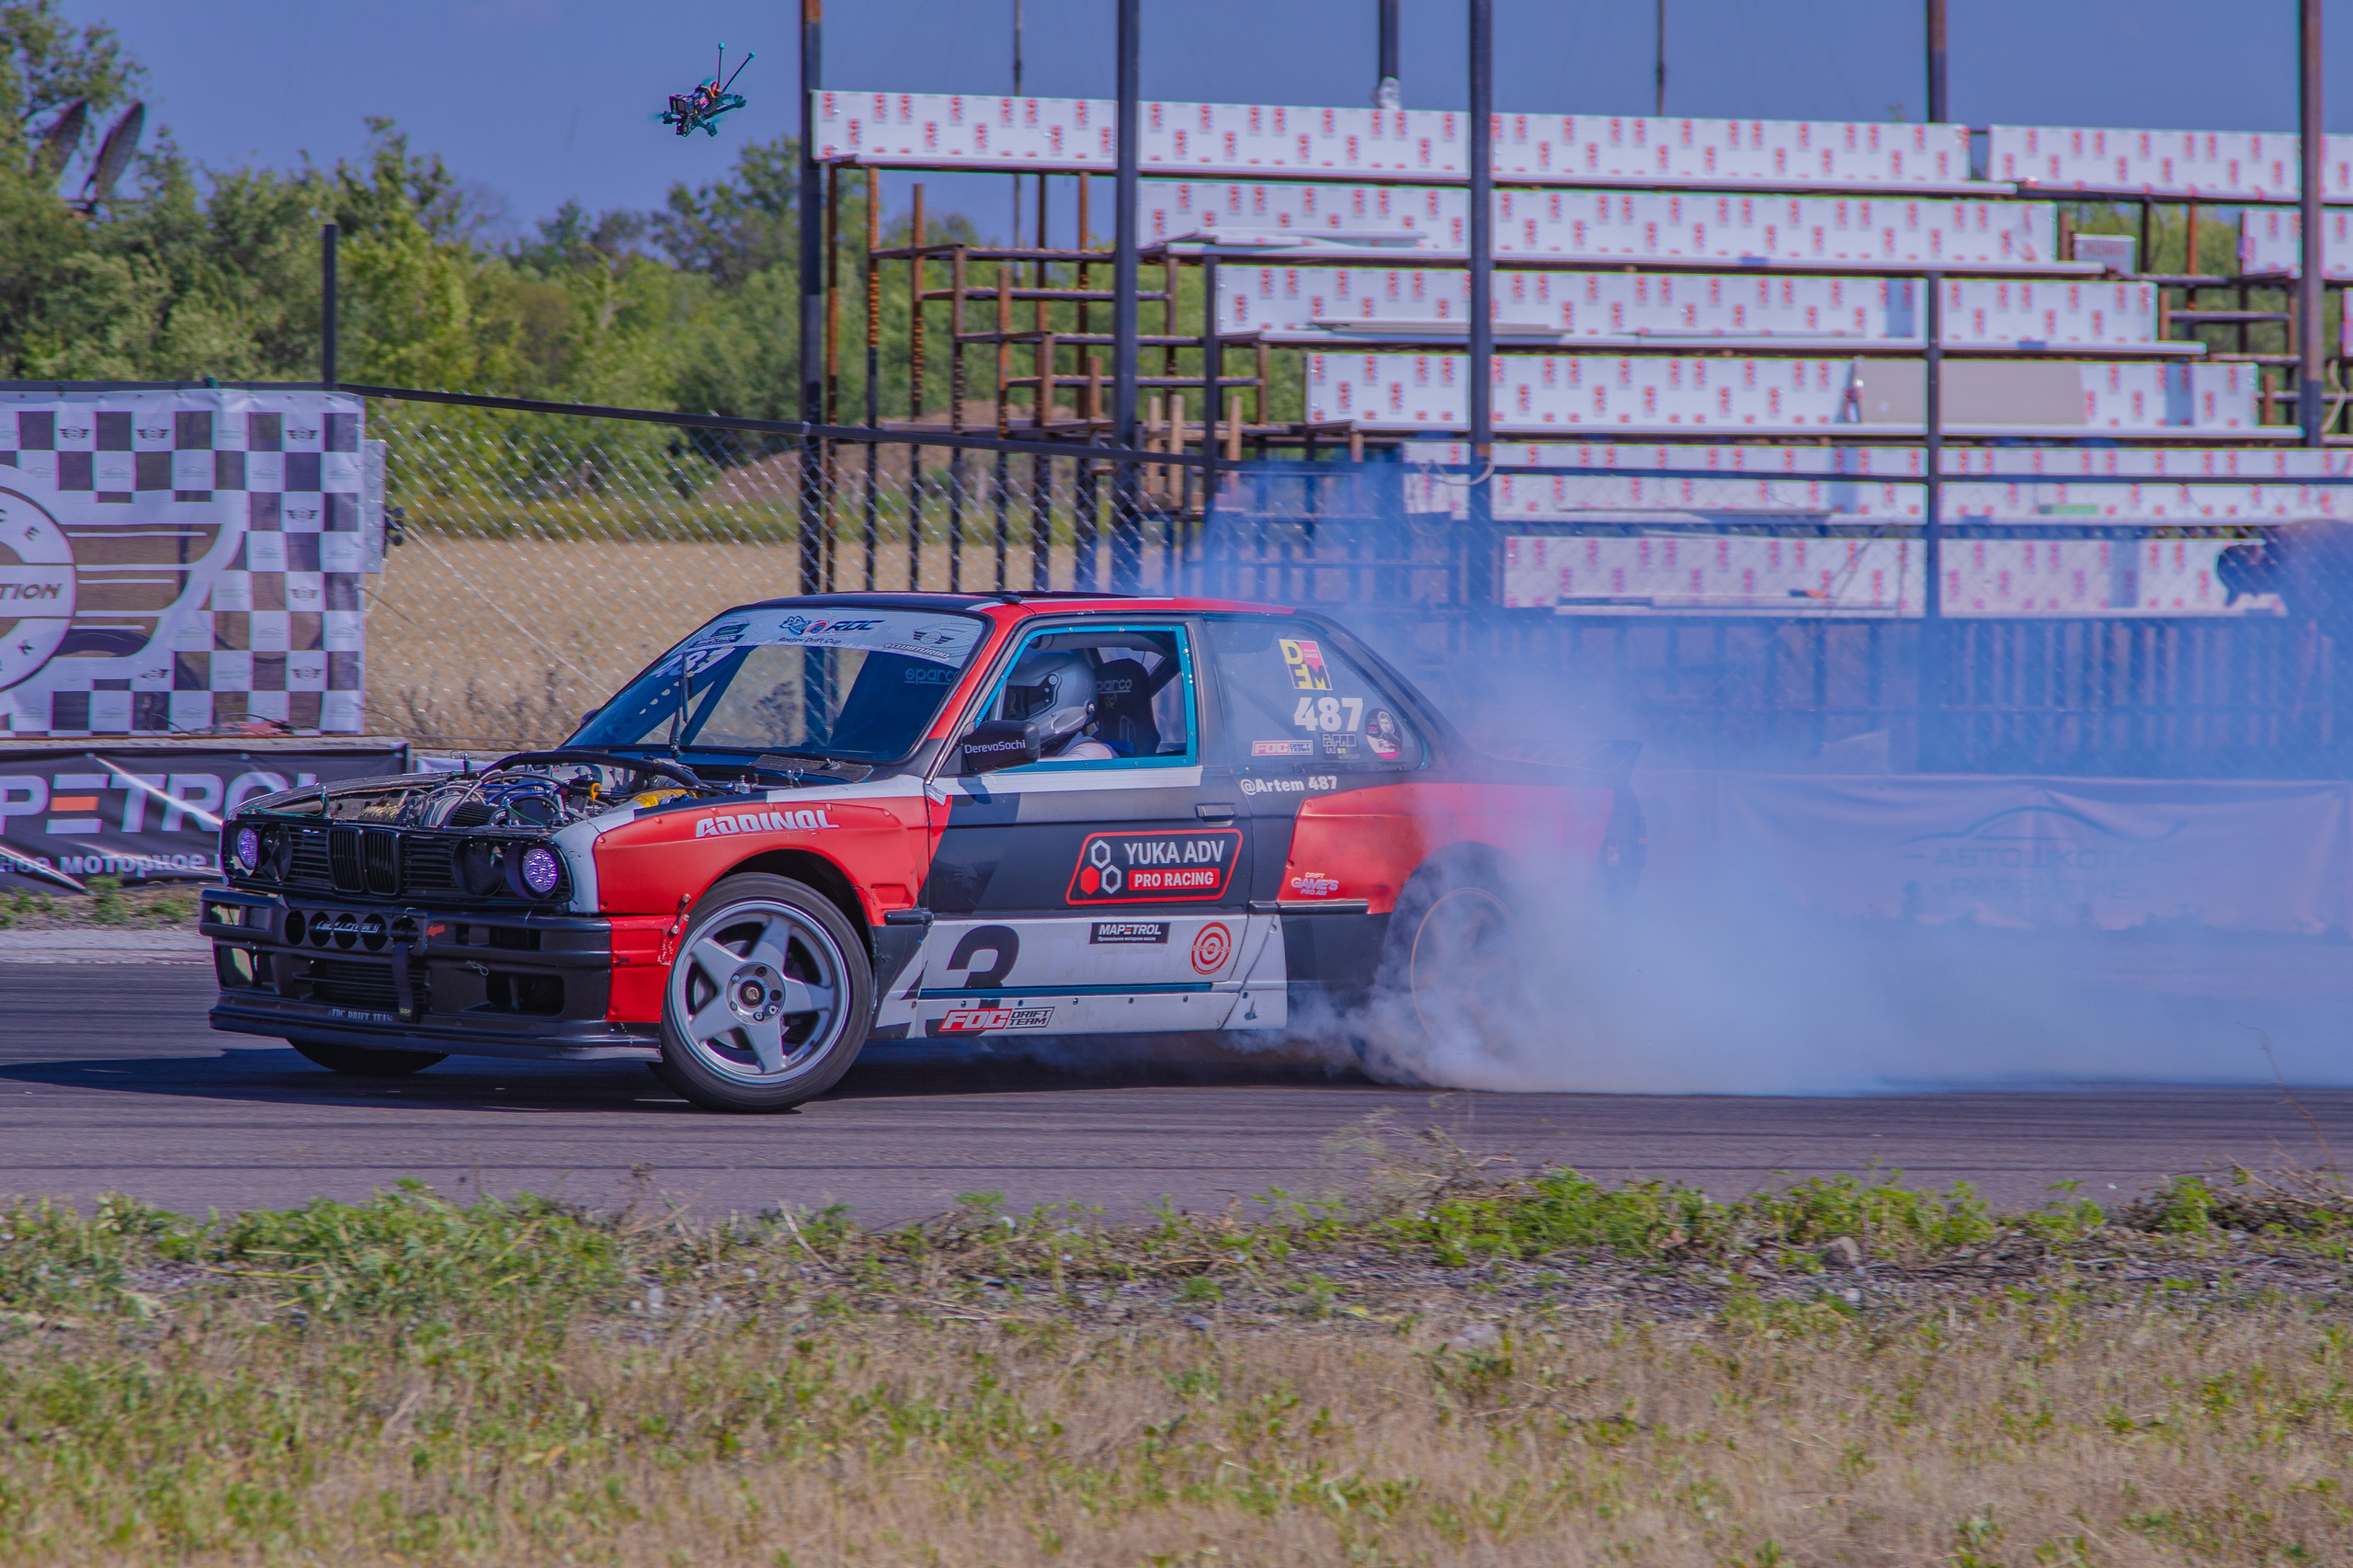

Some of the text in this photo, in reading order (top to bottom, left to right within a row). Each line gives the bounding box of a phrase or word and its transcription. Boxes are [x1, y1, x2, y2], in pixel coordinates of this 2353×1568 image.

[1097, 678, 1132, 691] parco
[1293, 697, 1364, 732] 487
[964, 739, 1027, 755] DerevoSochi
[1241, 776, 1337, 796] @Artem 487
[696, 810, 841, 838] ADDINOL
[1124, 840, 1224, 865] YUKA ADV
[59, 854, 209, 878] моторное
[1134, 871, 1214, 888] PRO RACING
[1290, 877, 1340, 892] GAME'S
[1098, 924, 1162, 936] MAPETROL
[332, 1008, 346, 1017] FDC
[347, 1010, 369, 1021] DRIFT
[1009, 1017, 1047, 1026] TEAM
[1010, 1010, 1051, 1018] DRIFT
